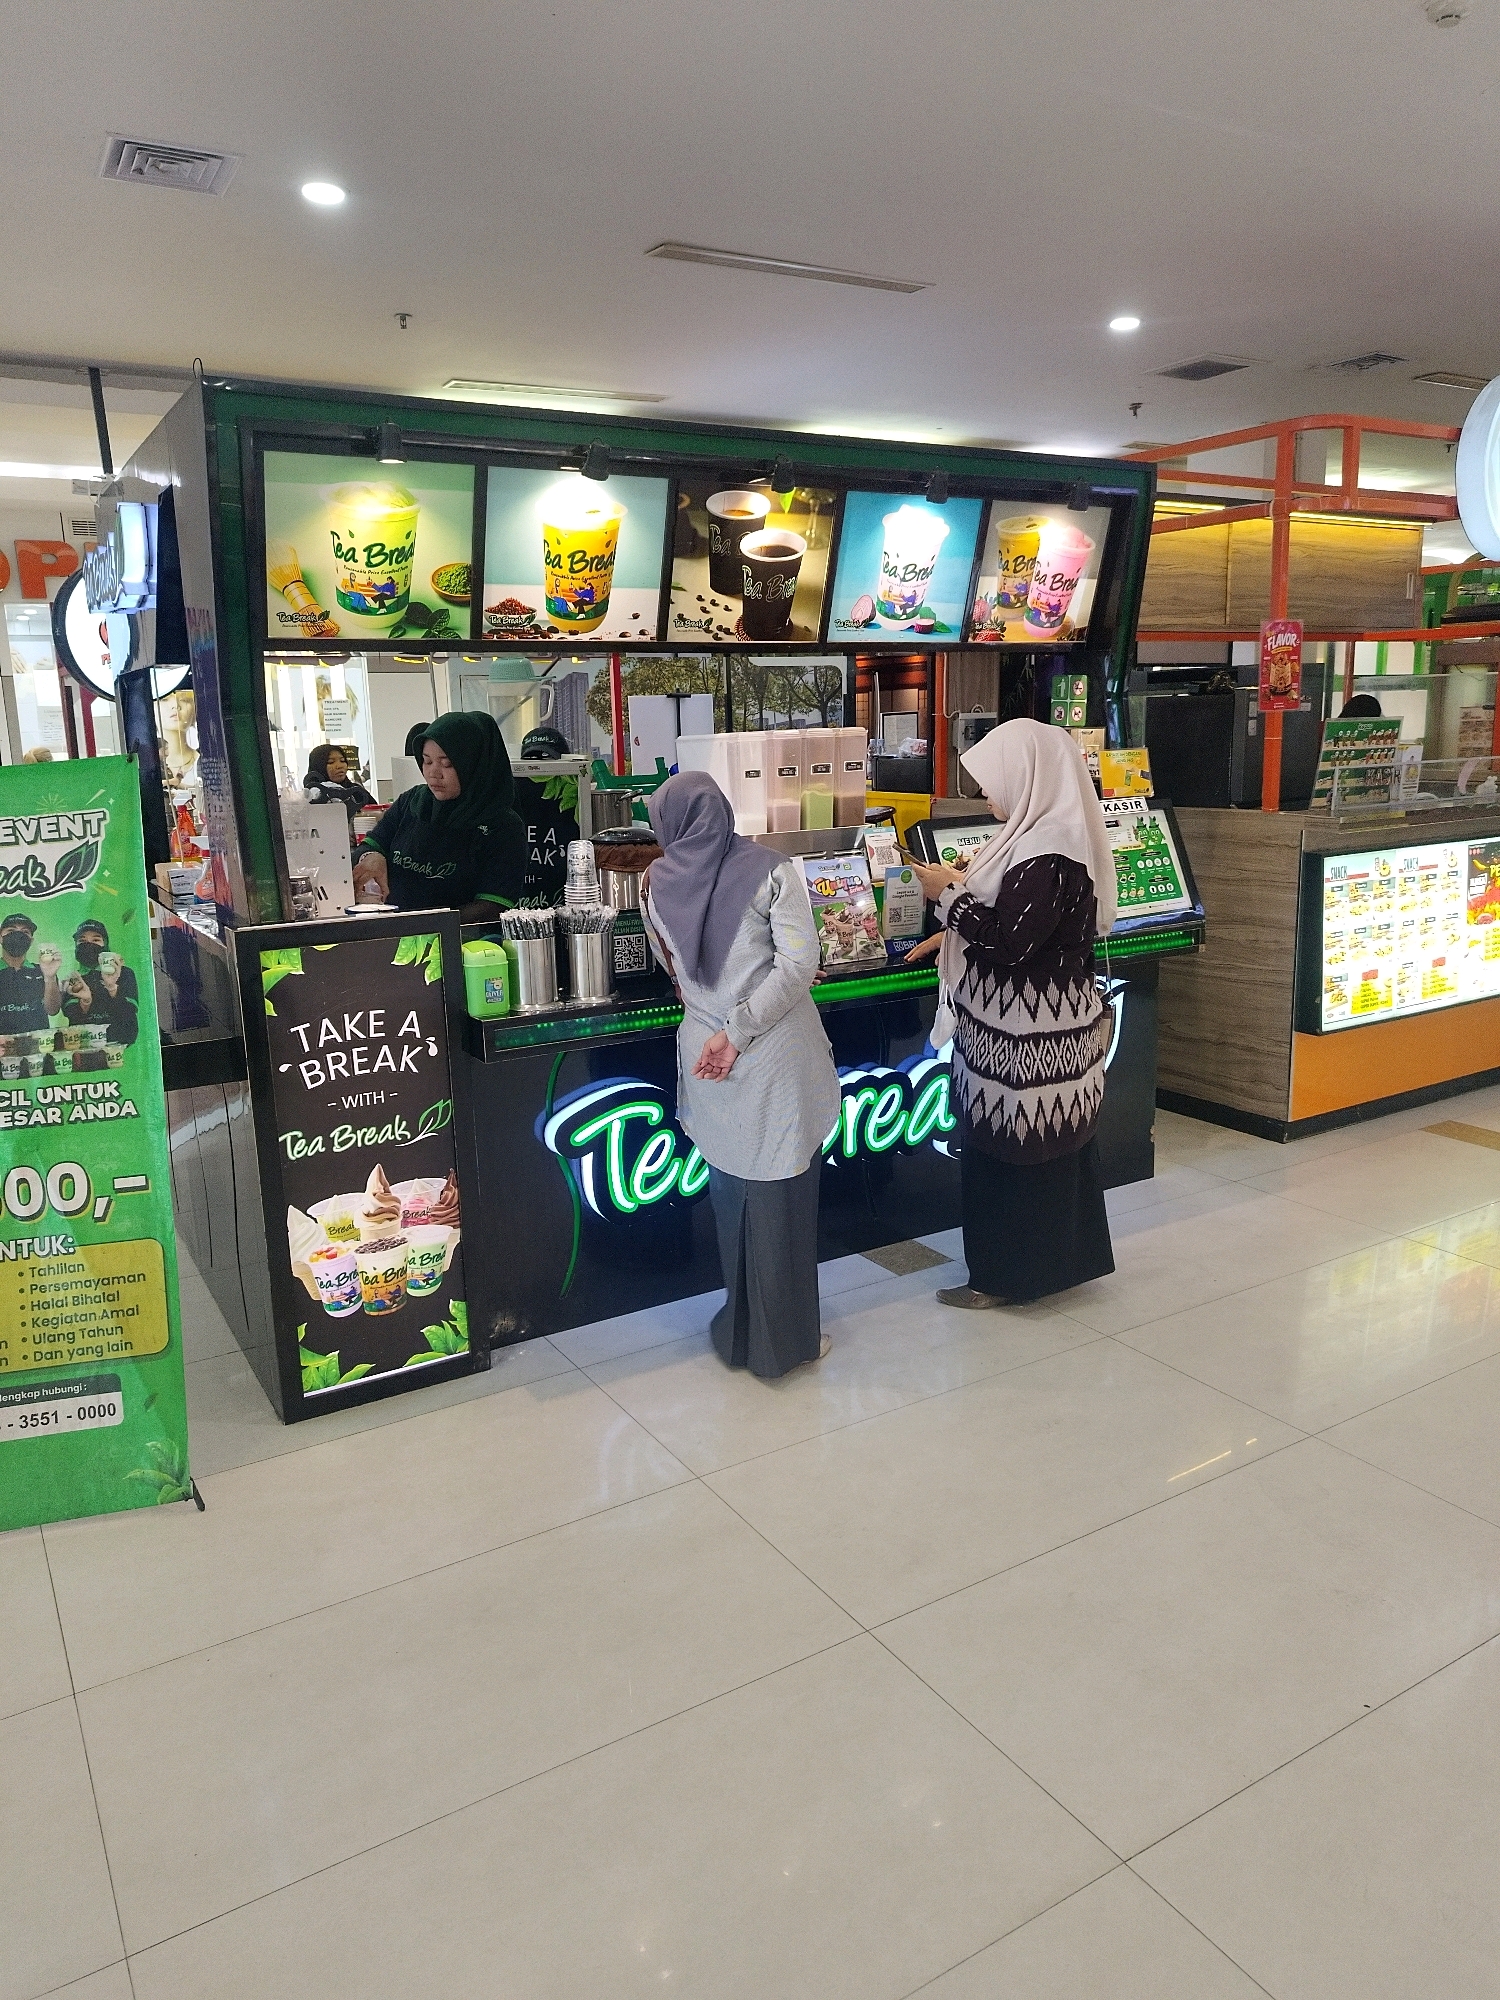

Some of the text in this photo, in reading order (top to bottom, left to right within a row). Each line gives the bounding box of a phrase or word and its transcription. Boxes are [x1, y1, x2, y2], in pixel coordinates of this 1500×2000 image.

[331, 530, 358, 563] Tea
[882, 551, 898, 578] Tea
[742, 565, 763, 599] Tea
[276, 611, 318, 623] Tea Break
[488, 615, 524, 626] Tea Break
[1267, 632, 1297, 651] FLAVOR
[1103, 801, 1142, 812] KASIR
[0, 812, 105, 844] EVENT
[543, 827, 556, 845] A
[957, 836, 980, 846] MENU
[402, 856, 432, 877] Break
[531, 847, 557, 867] AK
[0, 858, 48, 891] eak
[1330, 865, 1348, 881] SNACK
[514, 891, 549, 908] reak
[290, 1009, 421, 1052] TAKE A
[298, 1044, 423, 1089] BREAK
[0, 1082, 120, 1108] CIL UNTUK
[341, 1090, 385, 1109] WITH
[0, 1100, 138, 1128] ESAR ANDA
[822, 1073, 956, 1159] rea
[278, 1114, 411, 1161] Tea Break
[0, 1161, 148, 1220] 00,-
[0, 1235, 75, 1260] NTUK:
[29, 1263, 85, 1278] Tahlilan
[359, 1270, 379, 1286] Tea
[30, 1273, 146, 1294] Persemayaman
[31, 1290, 120, 1311] Halal Bihalal
[31, 1304, 140, 1329] Kegiatan Amal
[32, 1325, 124, 1345] Ulang Tahun
[34, 1341, 133, 1362] Dan yang lain
[42, 1383, 82, 1396] hubungi
[19, 1410, 59, 1429] 3551
[77, 1403, 116, 1420] 0000
